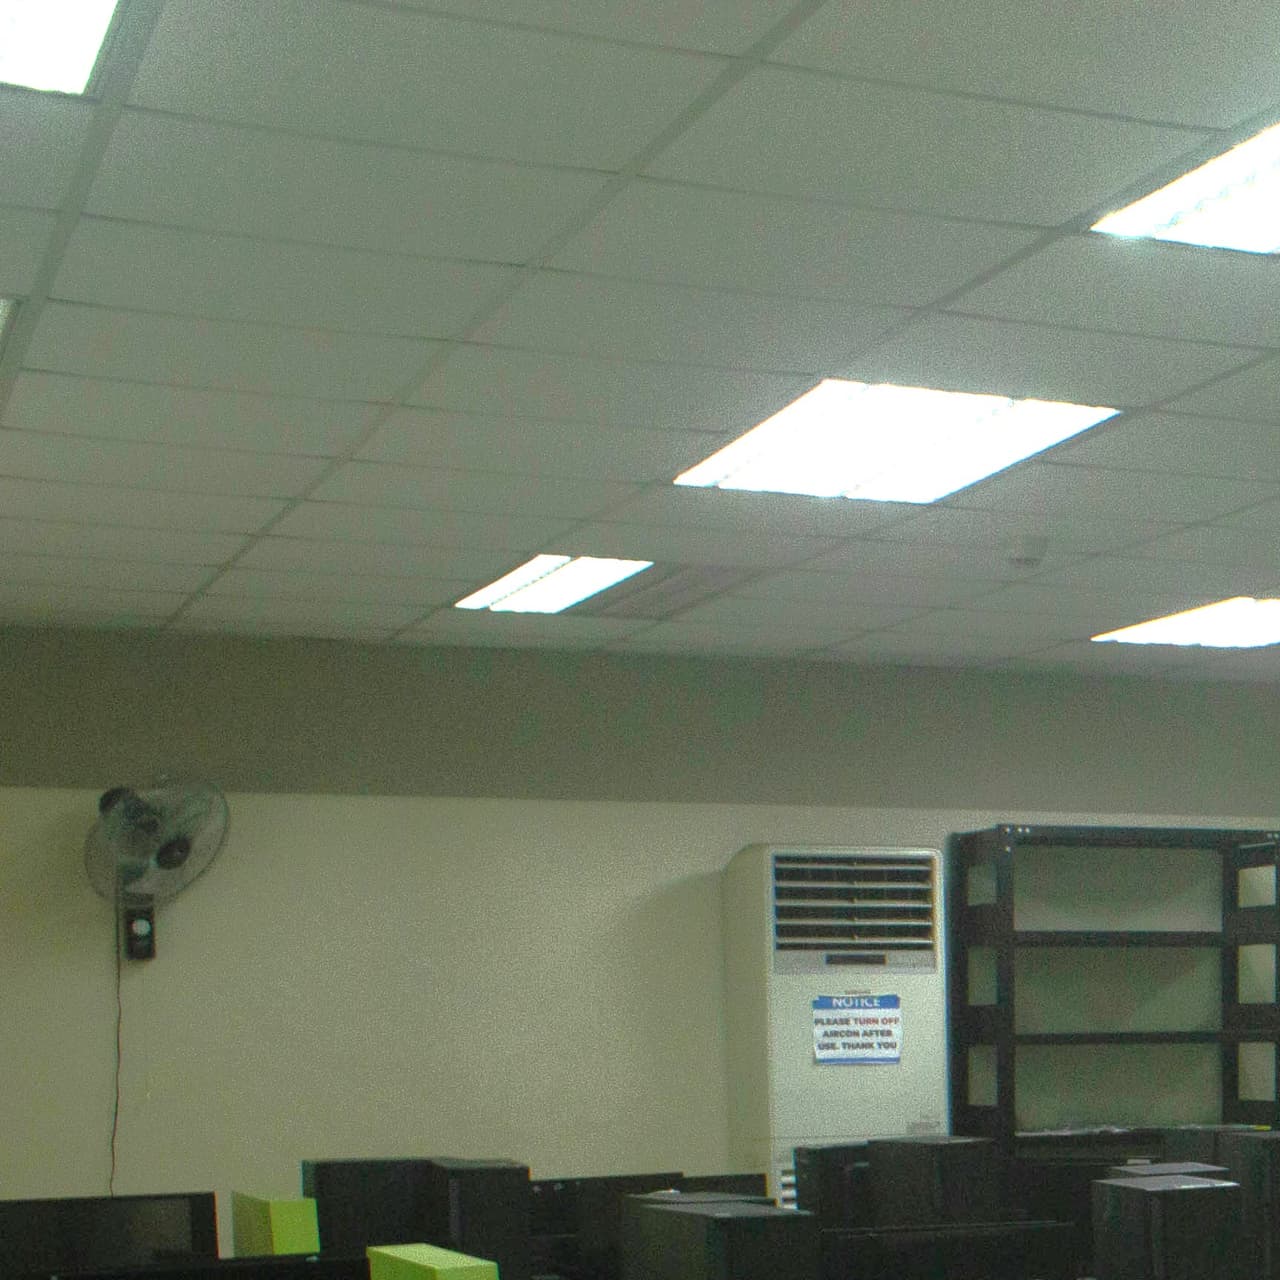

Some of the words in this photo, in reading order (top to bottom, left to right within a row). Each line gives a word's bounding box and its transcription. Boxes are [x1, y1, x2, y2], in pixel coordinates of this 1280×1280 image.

[832, 997, 881, 1008] NOTICE
[814, 1017, 850, 1026] PLEASE
[853, 1017, 879, 1025] TURN
[880, 1017, 899, 1025] OFF
[822, 1029, 860, 1038] AIRCON
[861, 1030, 893, 1038] AFTER
[841, 1042, 874, 1050] THANK
[876, 1041, 897, 1050] YOU
